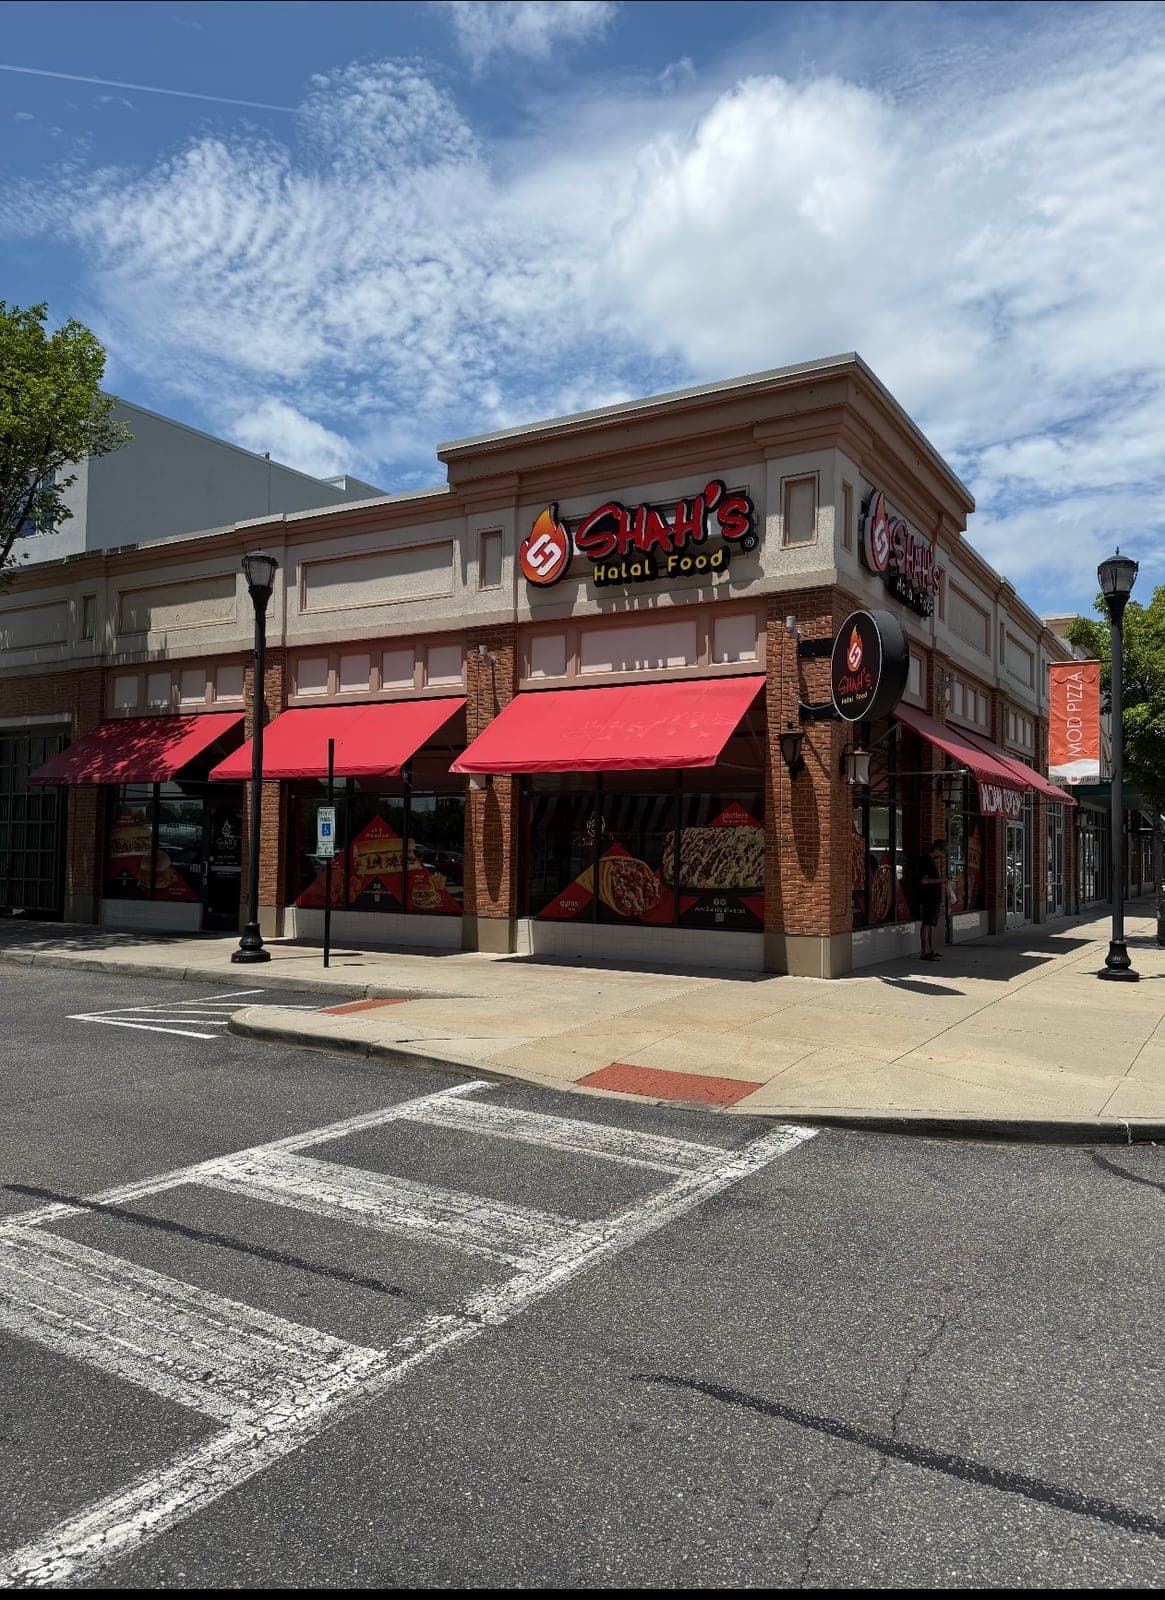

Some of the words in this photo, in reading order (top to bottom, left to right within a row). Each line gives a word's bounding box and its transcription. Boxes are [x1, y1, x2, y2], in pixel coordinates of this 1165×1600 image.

[575, 479, 752, 559] SHAH'S
[593, 559, 652, 582] Halal
[668, 549, 724, 573] Food
[1066, 671, 1083, 712] PIZZA
[1066, 716, 1083, 757] MOD
